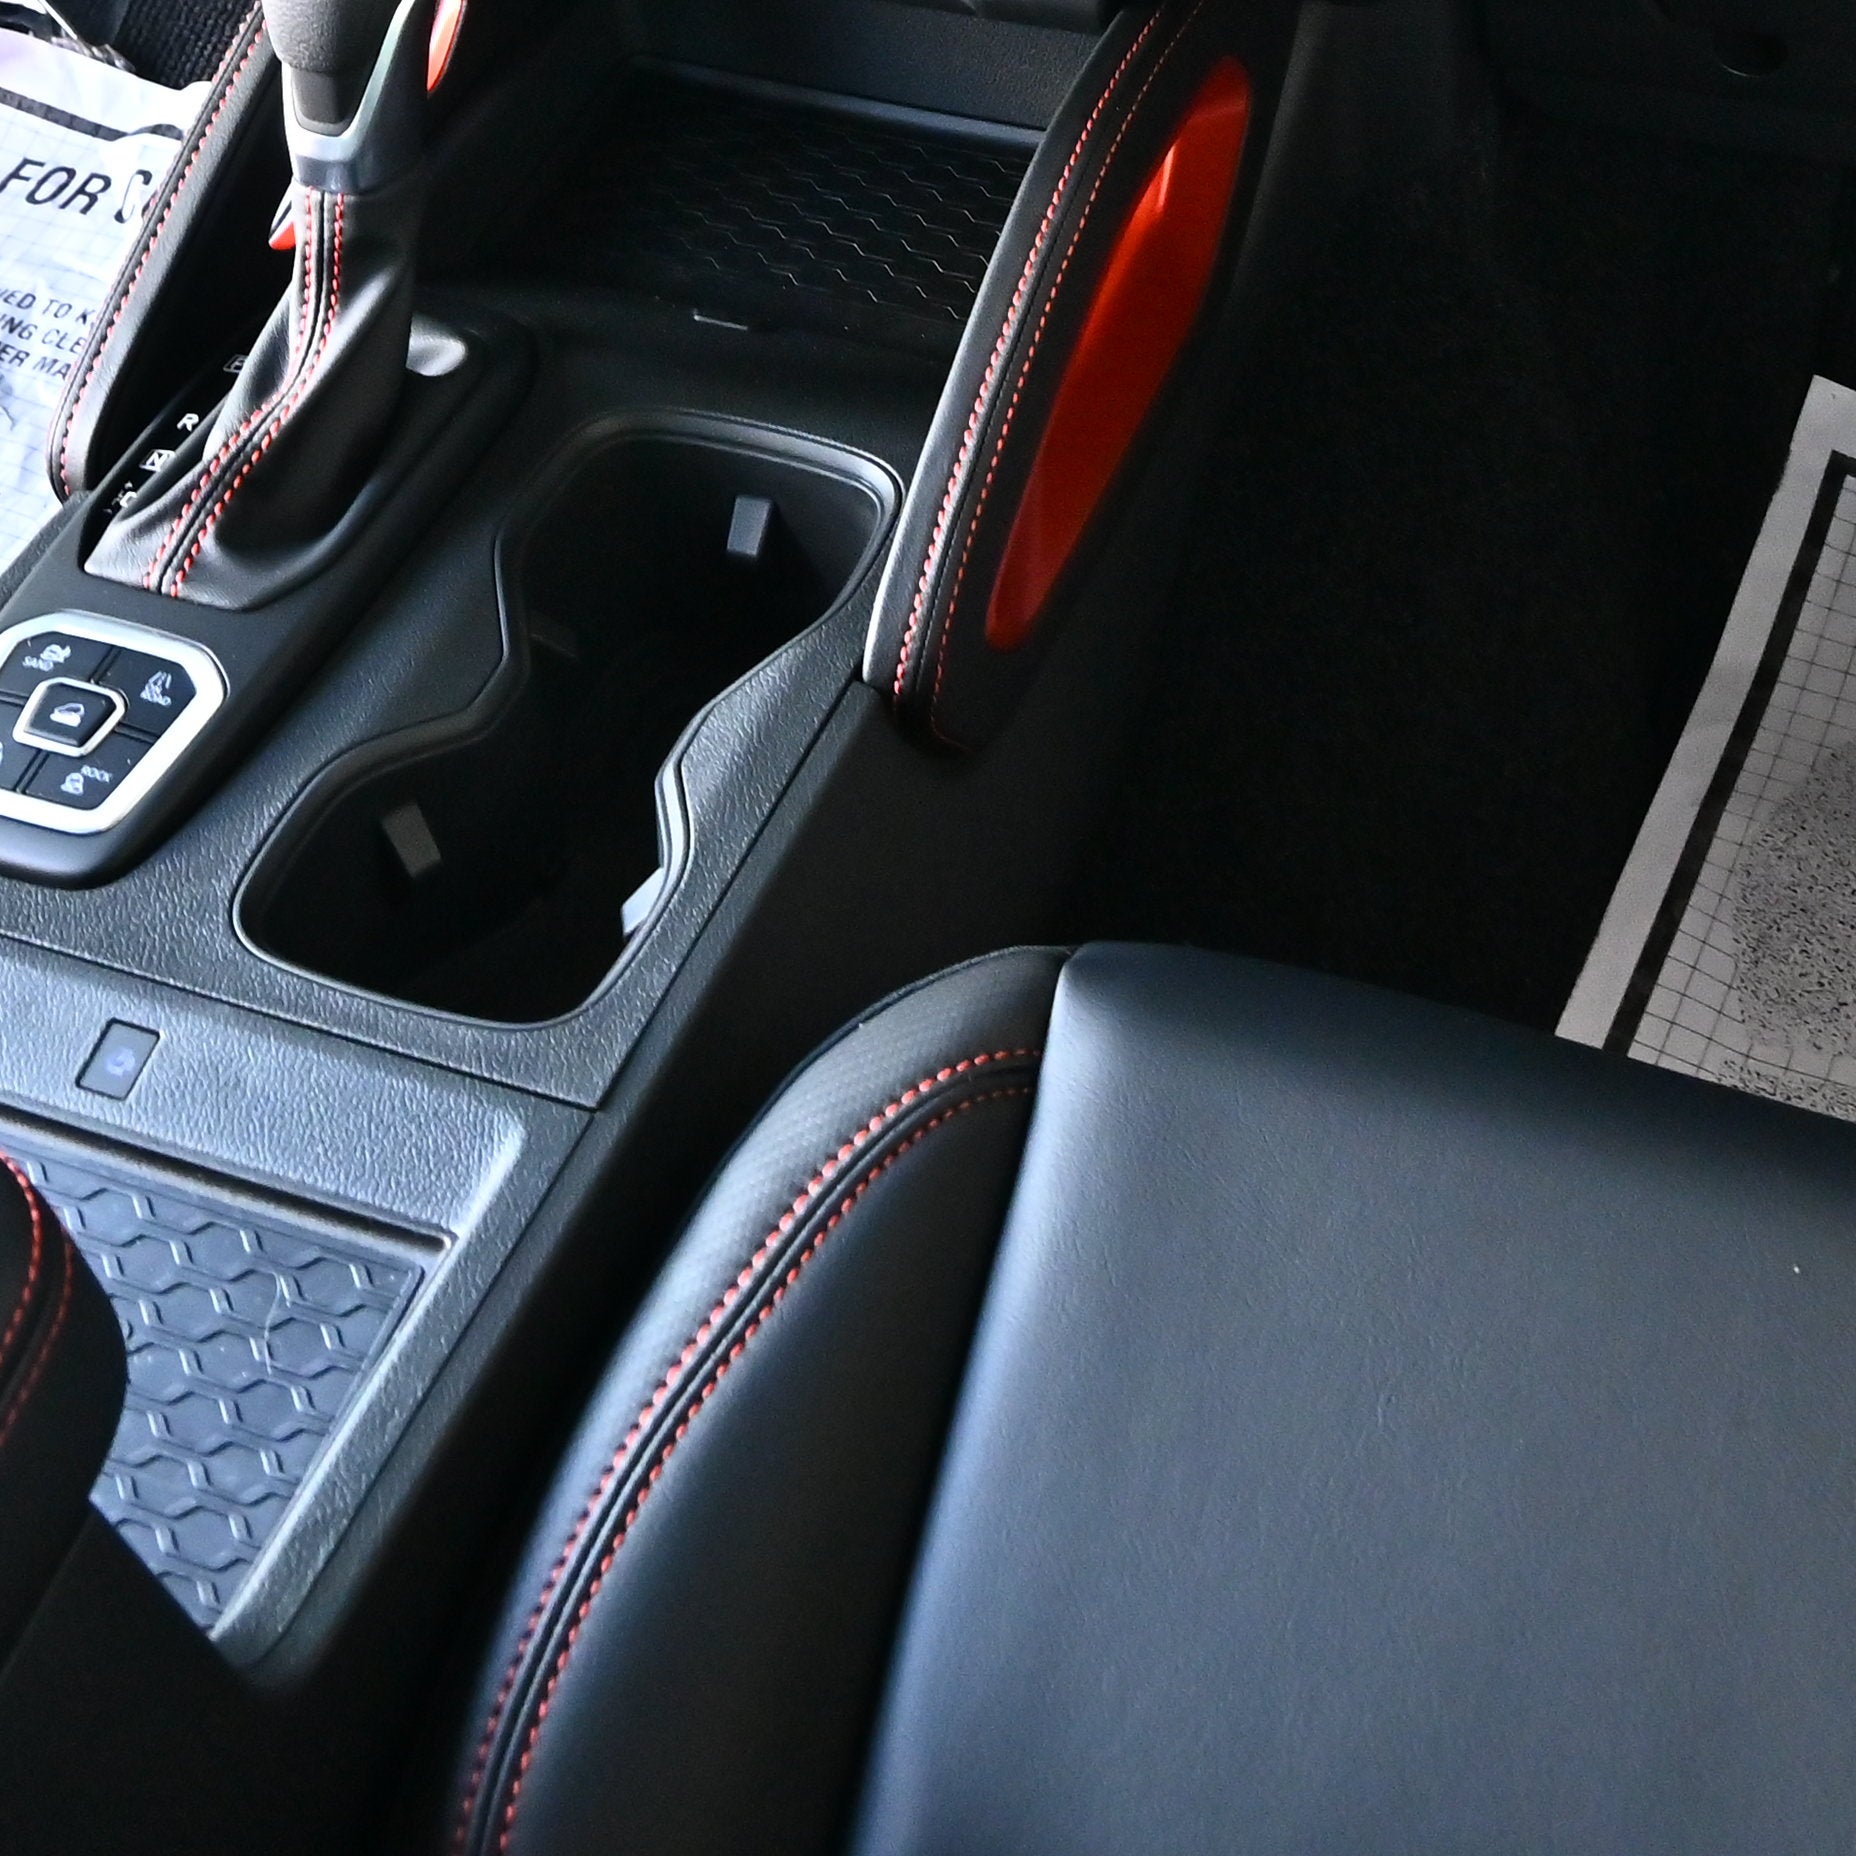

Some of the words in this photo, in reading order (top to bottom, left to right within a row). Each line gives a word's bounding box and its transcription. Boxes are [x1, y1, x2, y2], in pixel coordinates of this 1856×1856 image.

[41, 298, 73, 320] TO
[176, 412, 200, 433] R
[80, 764, 114, 784] ROCK
